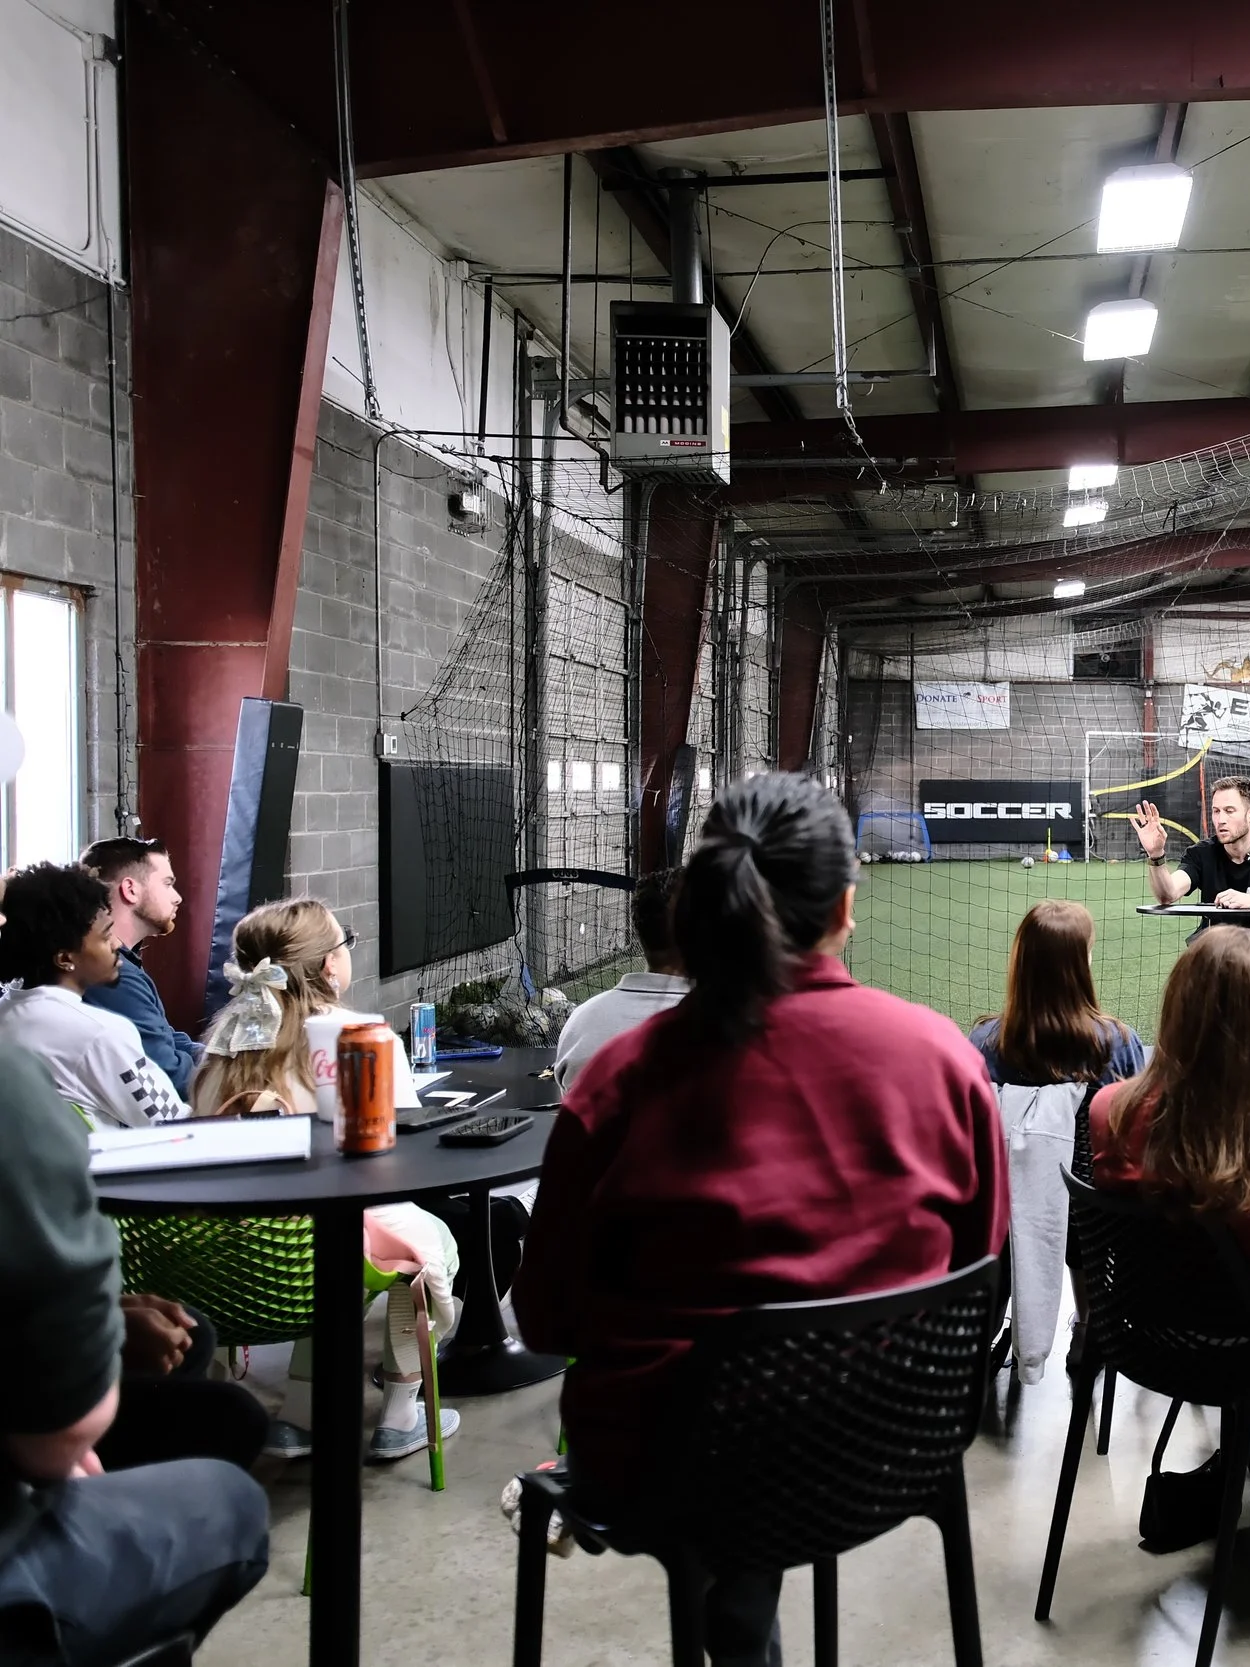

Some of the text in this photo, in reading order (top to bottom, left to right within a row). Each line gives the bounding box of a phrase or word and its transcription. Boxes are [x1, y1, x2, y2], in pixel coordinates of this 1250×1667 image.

[916, 694, 1008, 703] DONATE SPORT
[924, 802, 1073, 819] SOCCER
